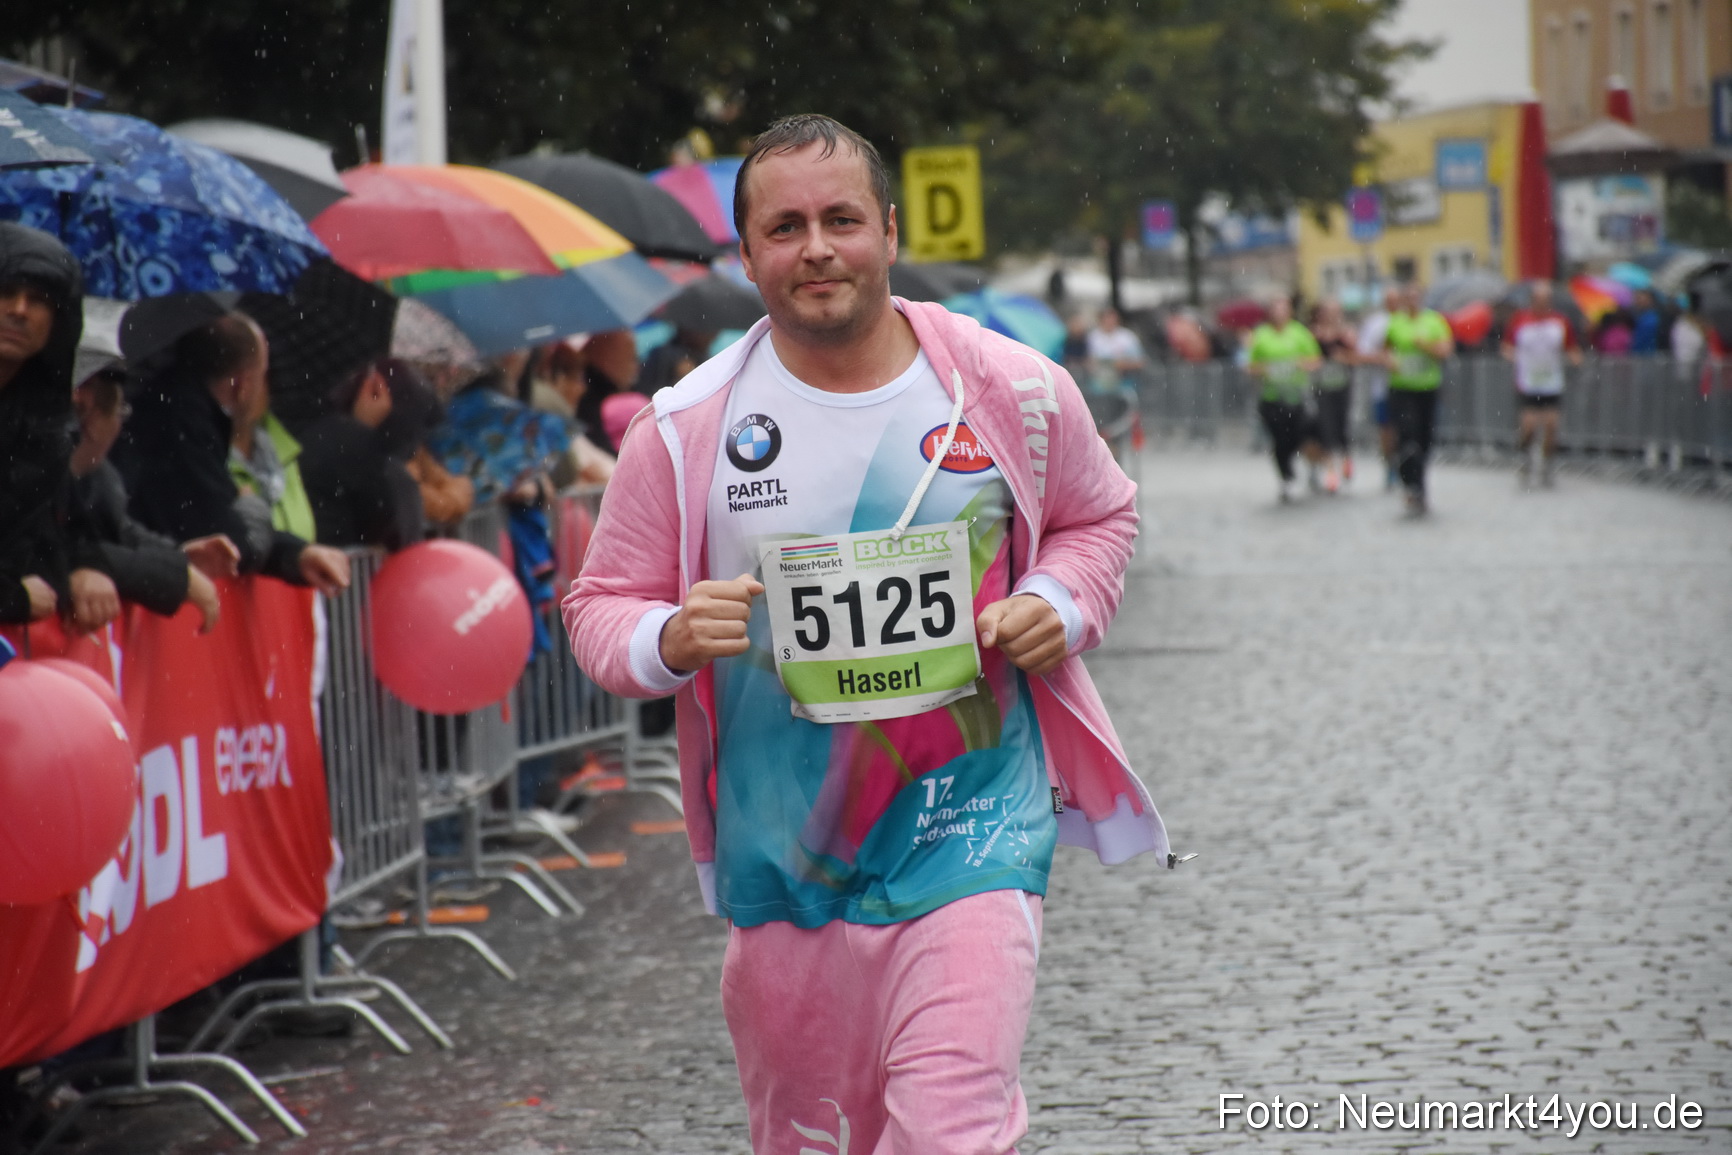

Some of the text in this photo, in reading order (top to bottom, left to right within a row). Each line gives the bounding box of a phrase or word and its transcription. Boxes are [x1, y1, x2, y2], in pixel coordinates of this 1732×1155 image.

[926, 184, 962, 235] D
[730, 415, 776, 437] BMW
[727, 478, 787, 501] PARTL
[728, 495, 788, 513] Neumarkt
[853, 531, 951, 561] BOCK
[779, 557, 843, 573] NeuerMarkt
[855, 553, 953, 570] inspired by smart concepts
[790, 570, 956, 652] 5125
[783, 648, 791, 660] S
[838, 661, 921, 695] Haserl
[921, 775, 955, 808] 17.
